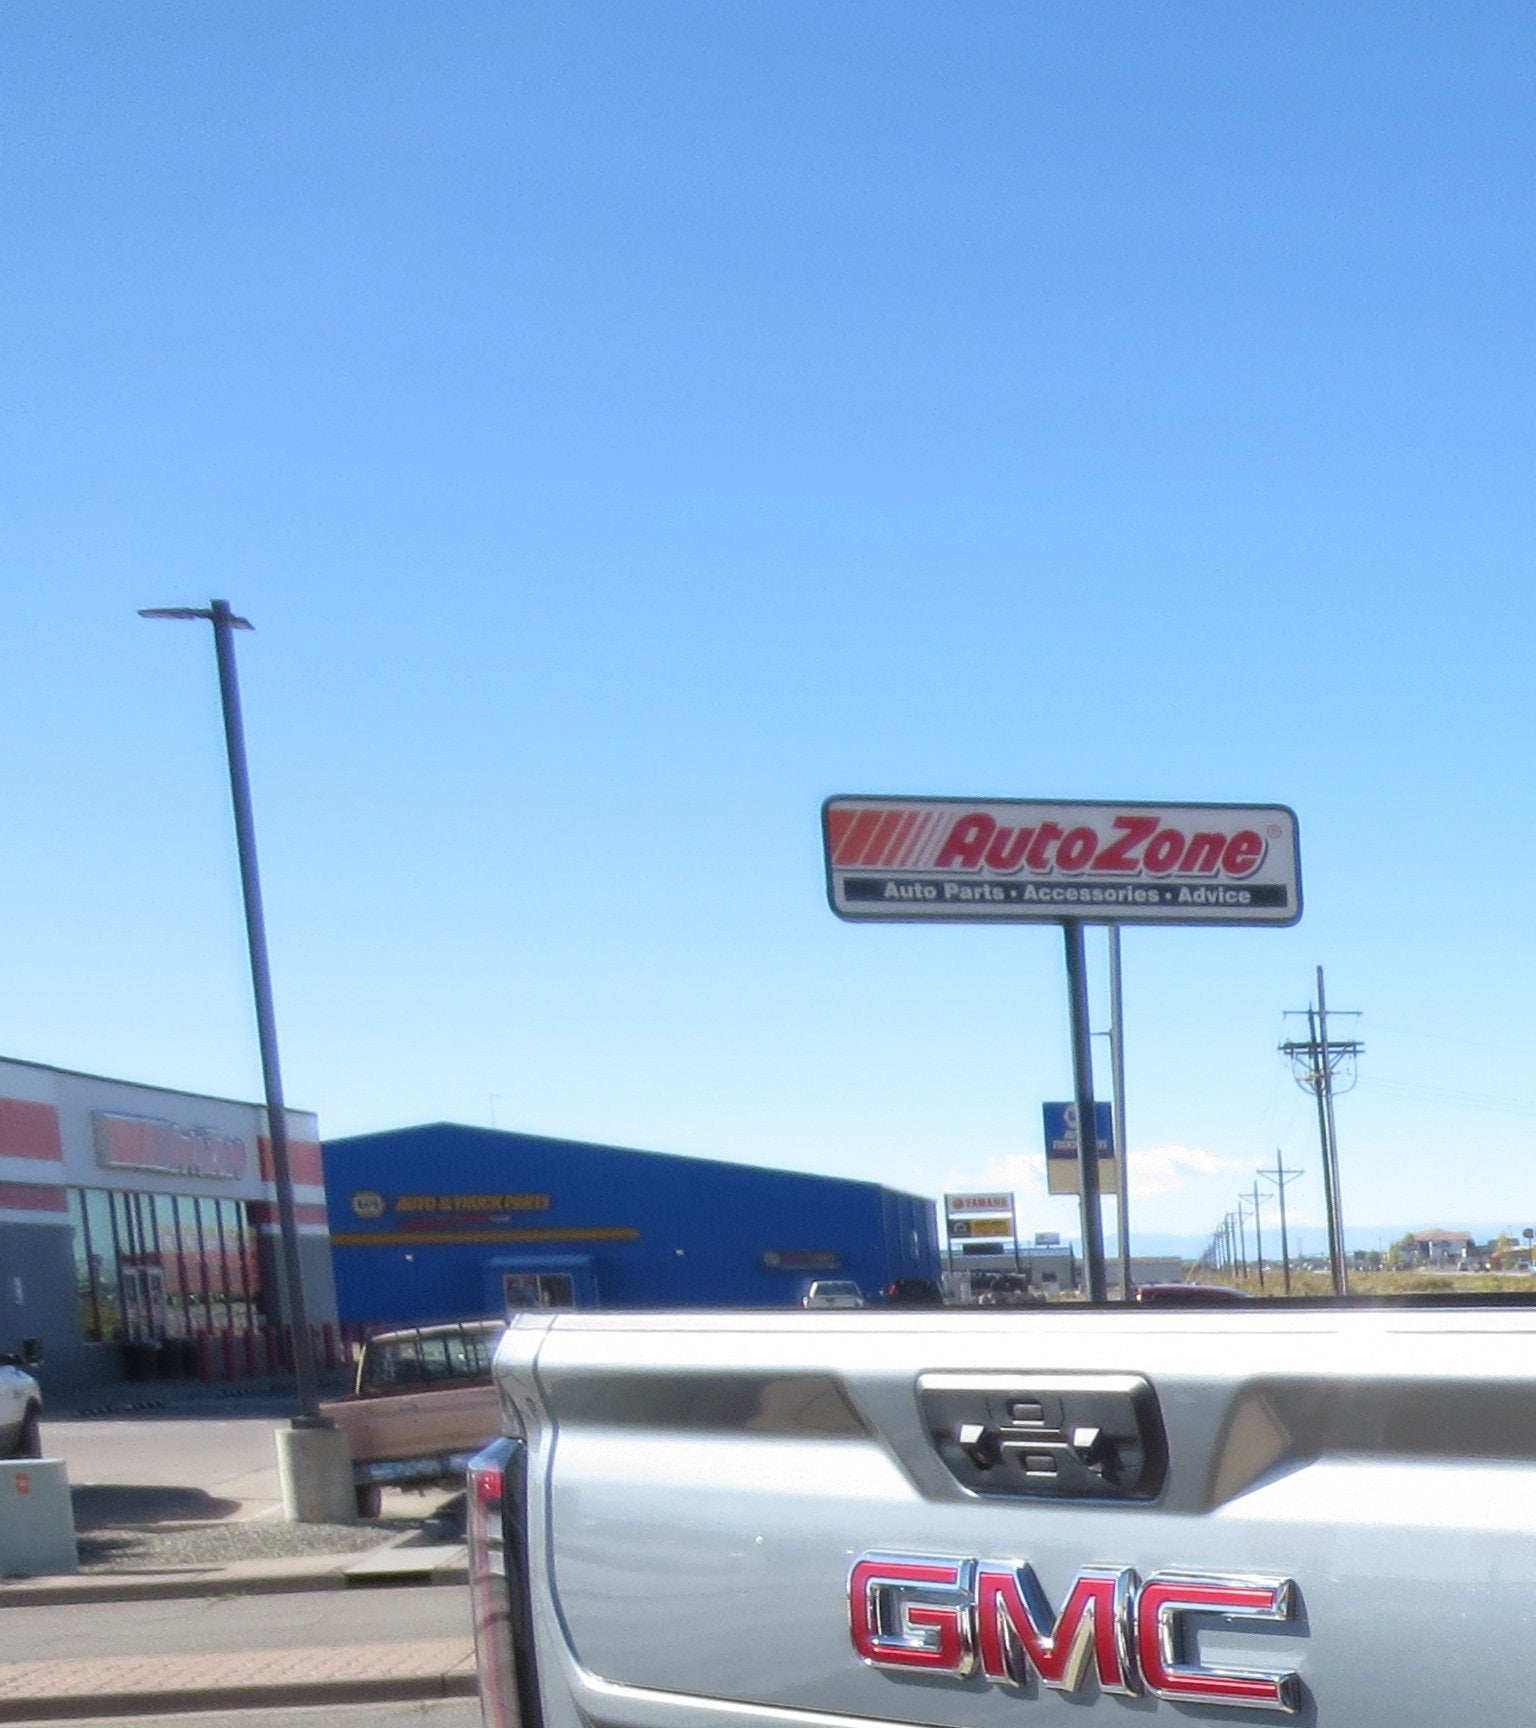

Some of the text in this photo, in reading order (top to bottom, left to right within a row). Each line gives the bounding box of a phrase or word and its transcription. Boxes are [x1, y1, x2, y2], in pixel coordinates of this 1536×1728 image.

[933, 812, 1267, 878] AutoZone
[883, 880, 1252, 905] Auto Parts Accessories Advice
[847, 1549, 1306, 1716] GMC
